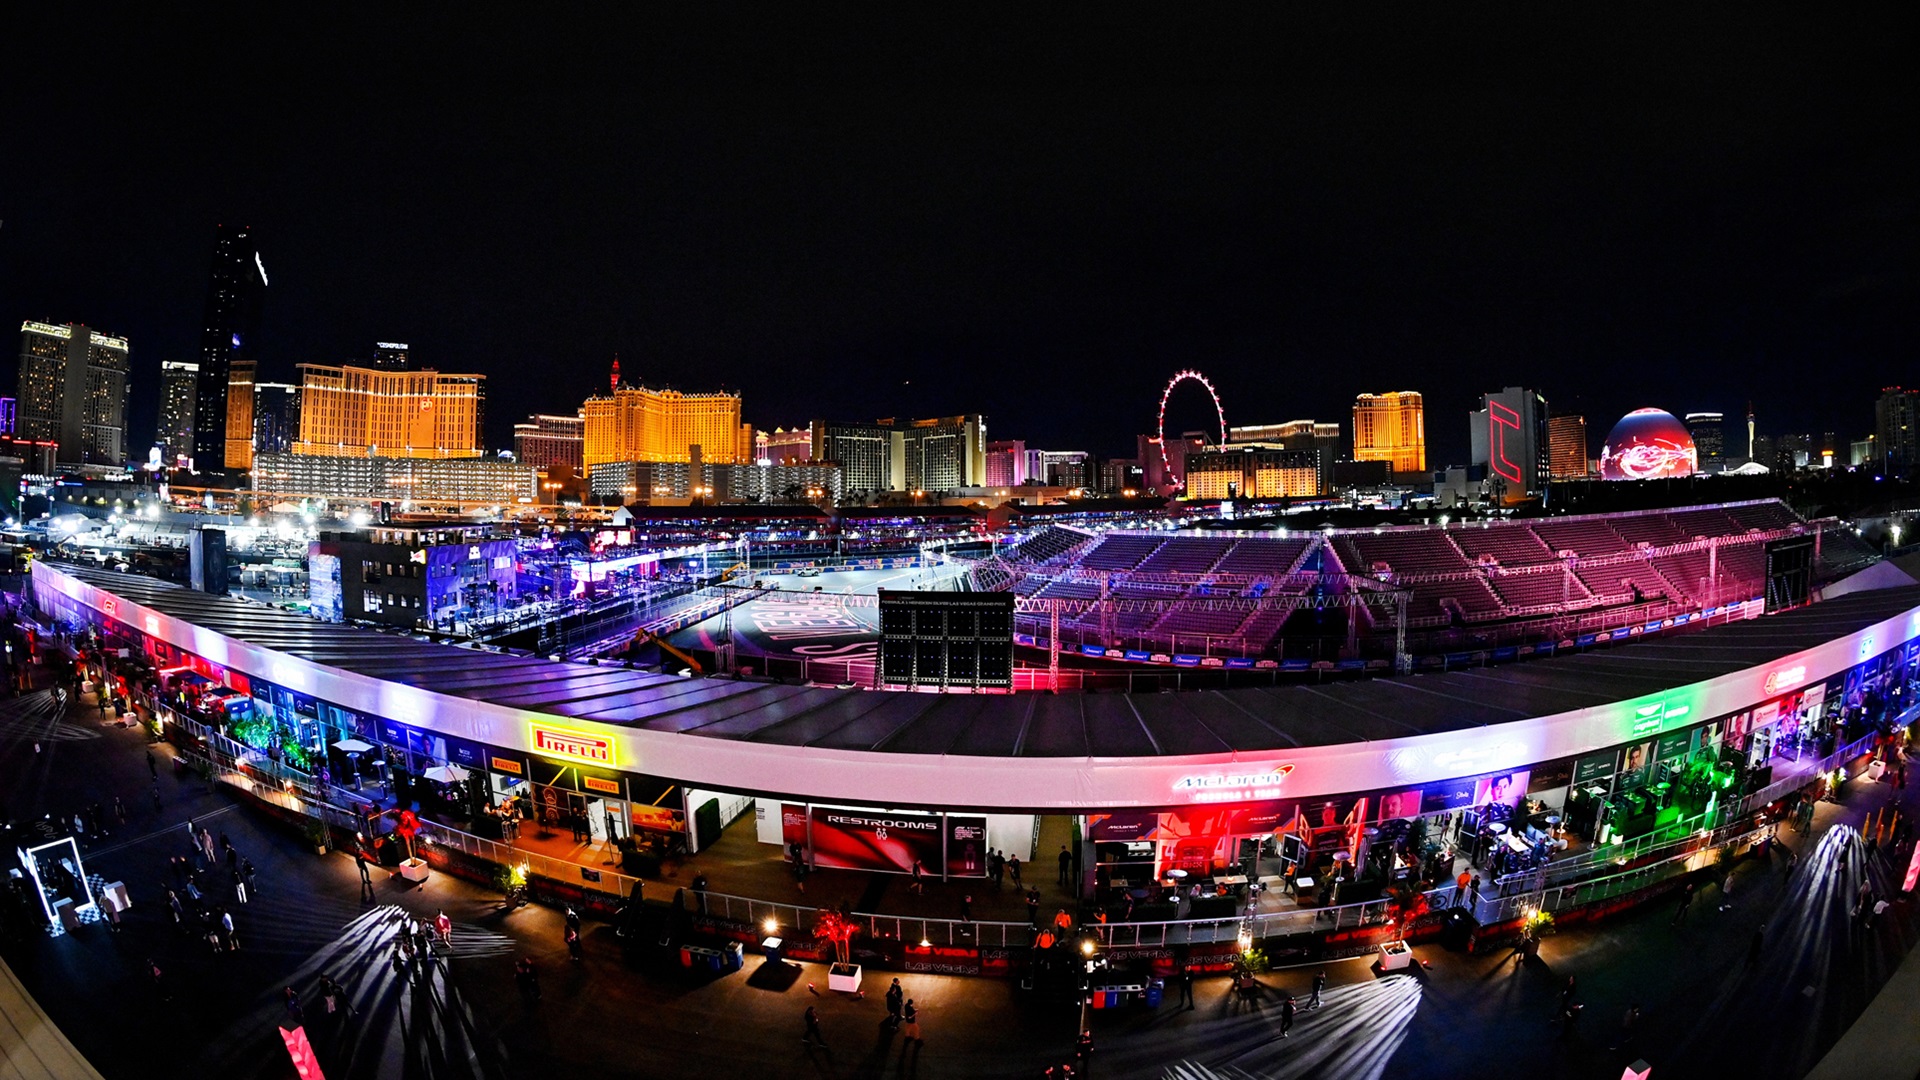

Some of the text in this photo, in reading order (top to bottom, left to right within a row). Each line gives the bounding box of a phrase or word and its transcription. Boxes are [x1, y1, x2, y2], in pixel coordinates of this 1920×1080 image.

[536, 729, 607, 760] PIRELLI
[587, 779, 617, 791] PIRELLI
[1173, 772, 1282, 788] McLaren
[827, 815, 938, 830] RESTROOMS
[905, 945, 979, 958] LAS VEGAS
[904, 961, 979, 975] LAS VEGAS
